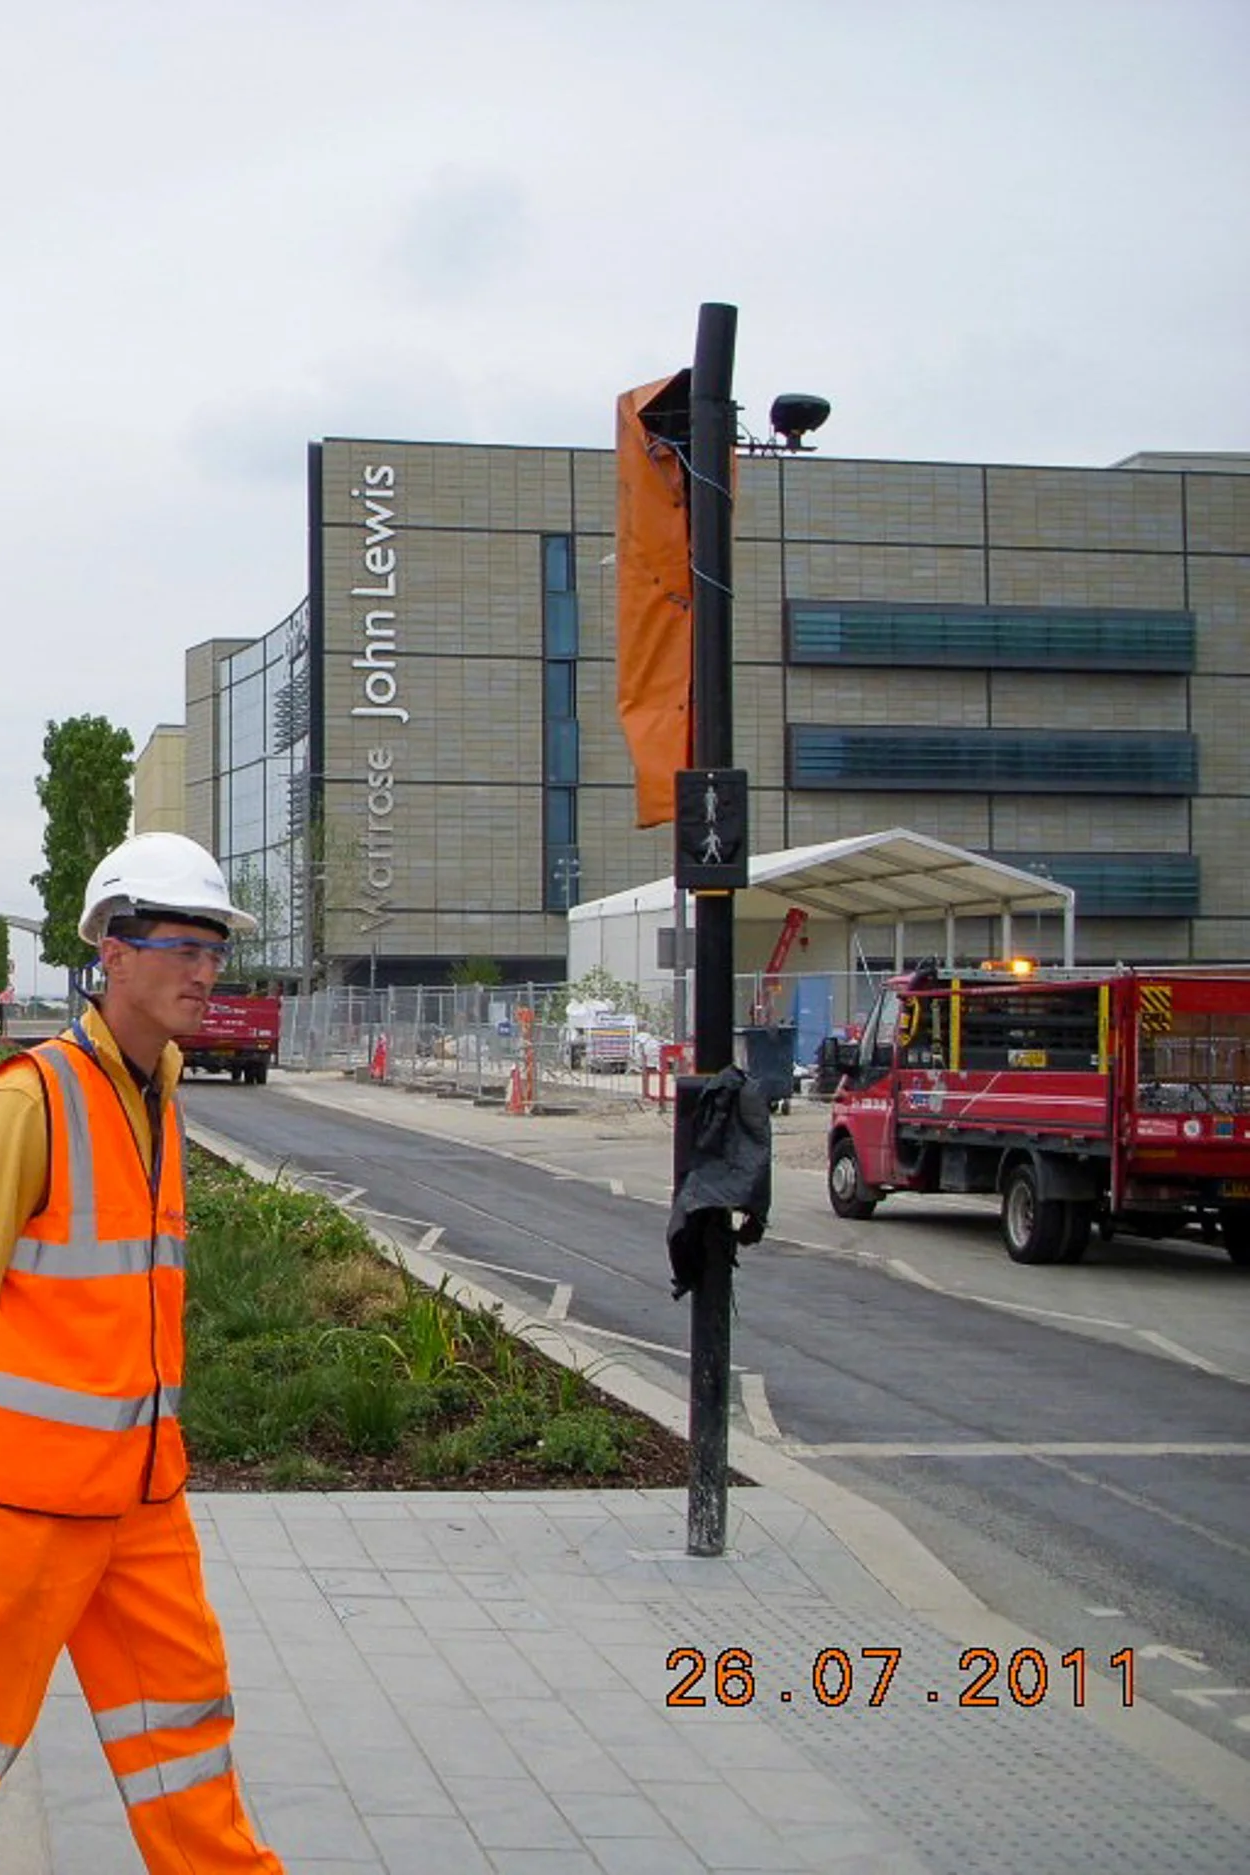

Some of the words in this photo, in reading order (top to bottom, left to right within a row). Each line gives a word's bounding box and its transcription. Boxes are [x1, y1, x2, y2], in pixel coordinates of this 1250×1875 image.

[350, 465, 396, 598] Lewis
[351, 609, 410, 723] John
[359, 746, 394, 935] Waitrose
